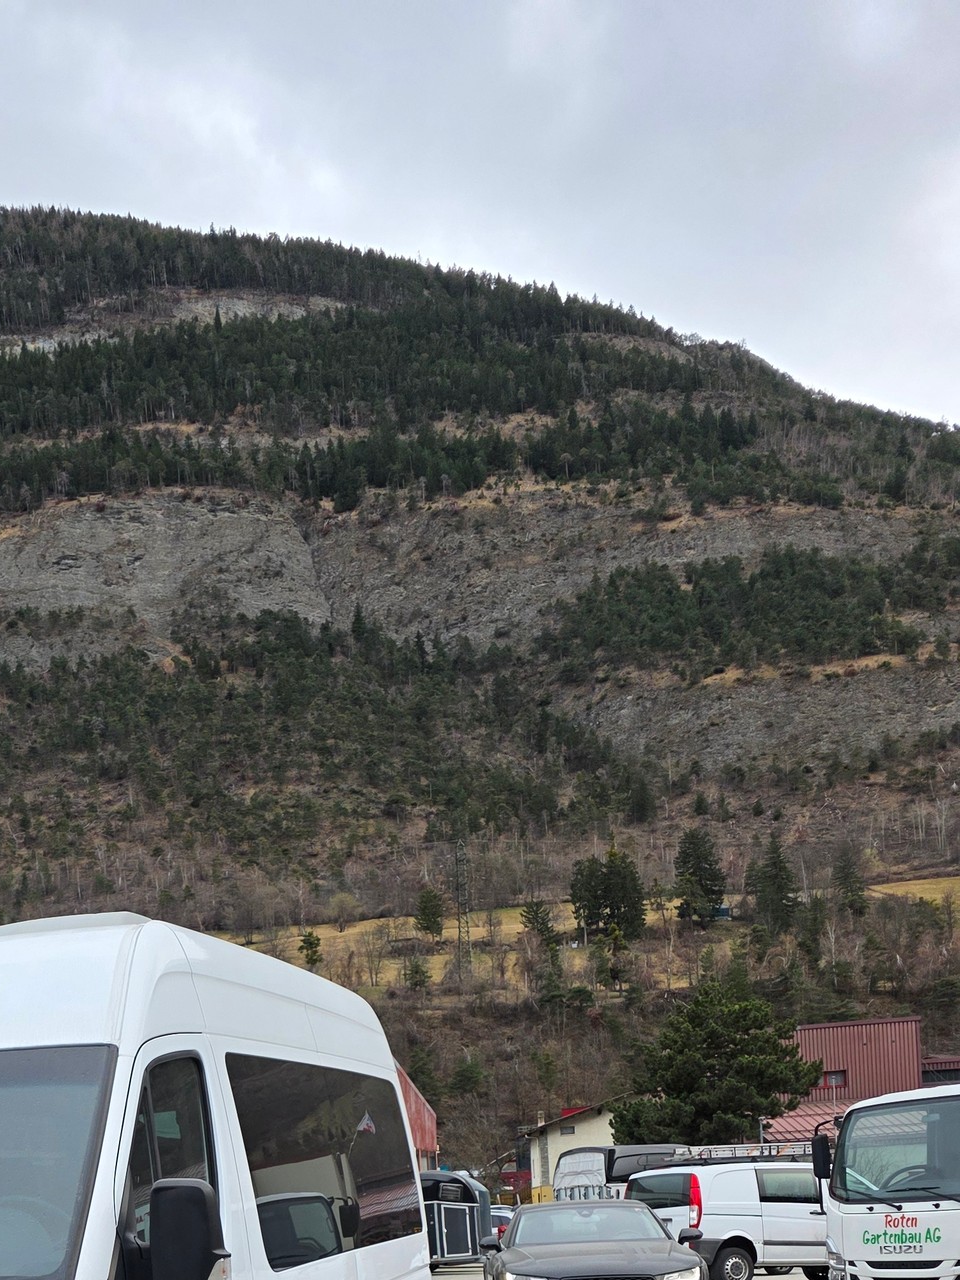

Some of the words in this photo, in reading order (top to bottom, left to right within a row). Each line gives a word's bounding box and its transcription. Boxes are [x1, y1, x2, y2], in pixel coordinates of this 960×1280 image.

[884, 1214, 918, 1228] Roten
[863, 1229, 921, 1244] Gartenbau
[925, 1227, 942, 1243] AG
[880, 1245, 923, 1255] ISUZU
